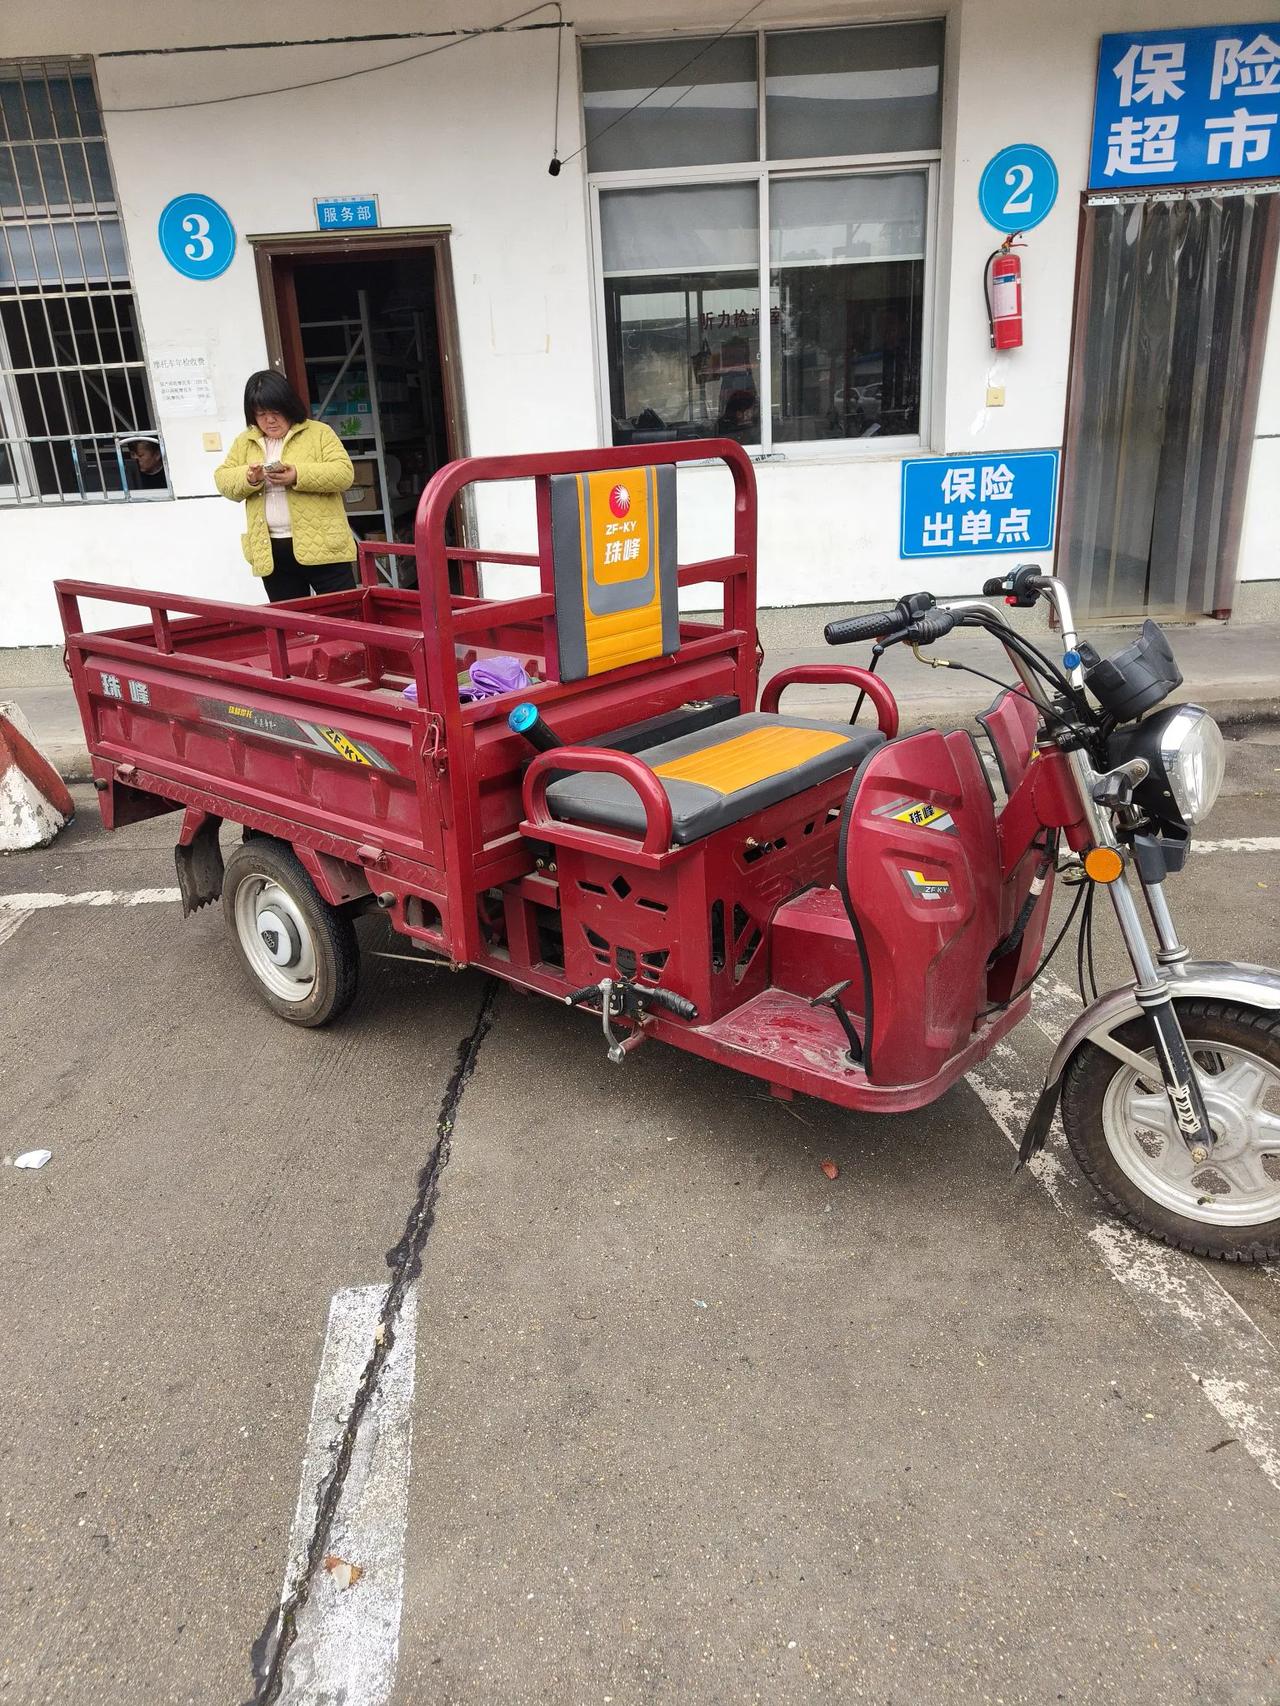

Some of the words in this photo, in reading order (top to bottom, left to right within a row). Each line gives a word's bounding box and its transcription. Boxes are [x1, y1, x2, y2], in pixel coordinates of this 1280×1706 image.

[1113, 34, 1280, 106] 保险
[1104, 107, 1278, 176] 超市
[1003, 164, 1034, 214] 2
[323, 205, 372, 223] 服务部
[182, 213, 214, 262] 3
[941, 463, 1016, 504] 保险
[605, 520, 637, 536] ZF-KY
[922, 507, 1032, 547] 出单点
[603, 537, 641, 565] 珠峰
[99, 671, 151, 706] 珠峰
[909, 805, 935, 824] 珠峰
